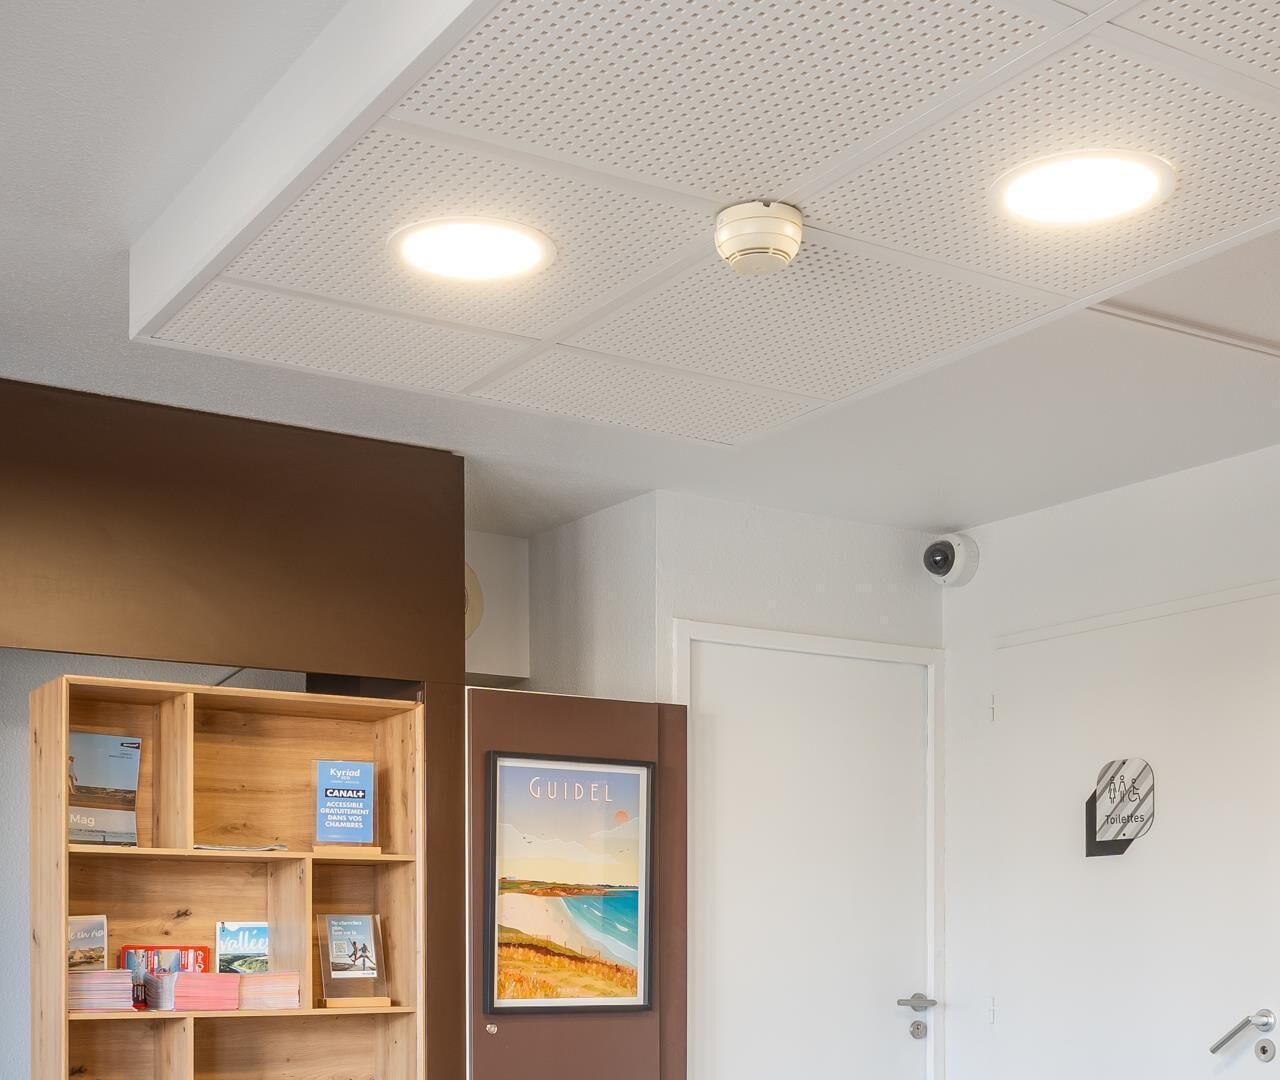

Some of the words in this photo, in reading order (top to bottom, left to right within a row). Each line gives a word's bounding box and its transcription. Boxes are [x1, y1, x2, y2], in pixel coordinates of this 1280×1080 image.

[329, 768, 361, 778] Kyriad
[326, 789, 365, 798] CANAL+
[529, 776, 613, 802] GUIDEL
[70, 814, 95, 827] Mag
[1104, 814, 1145, 825] Toilettes
